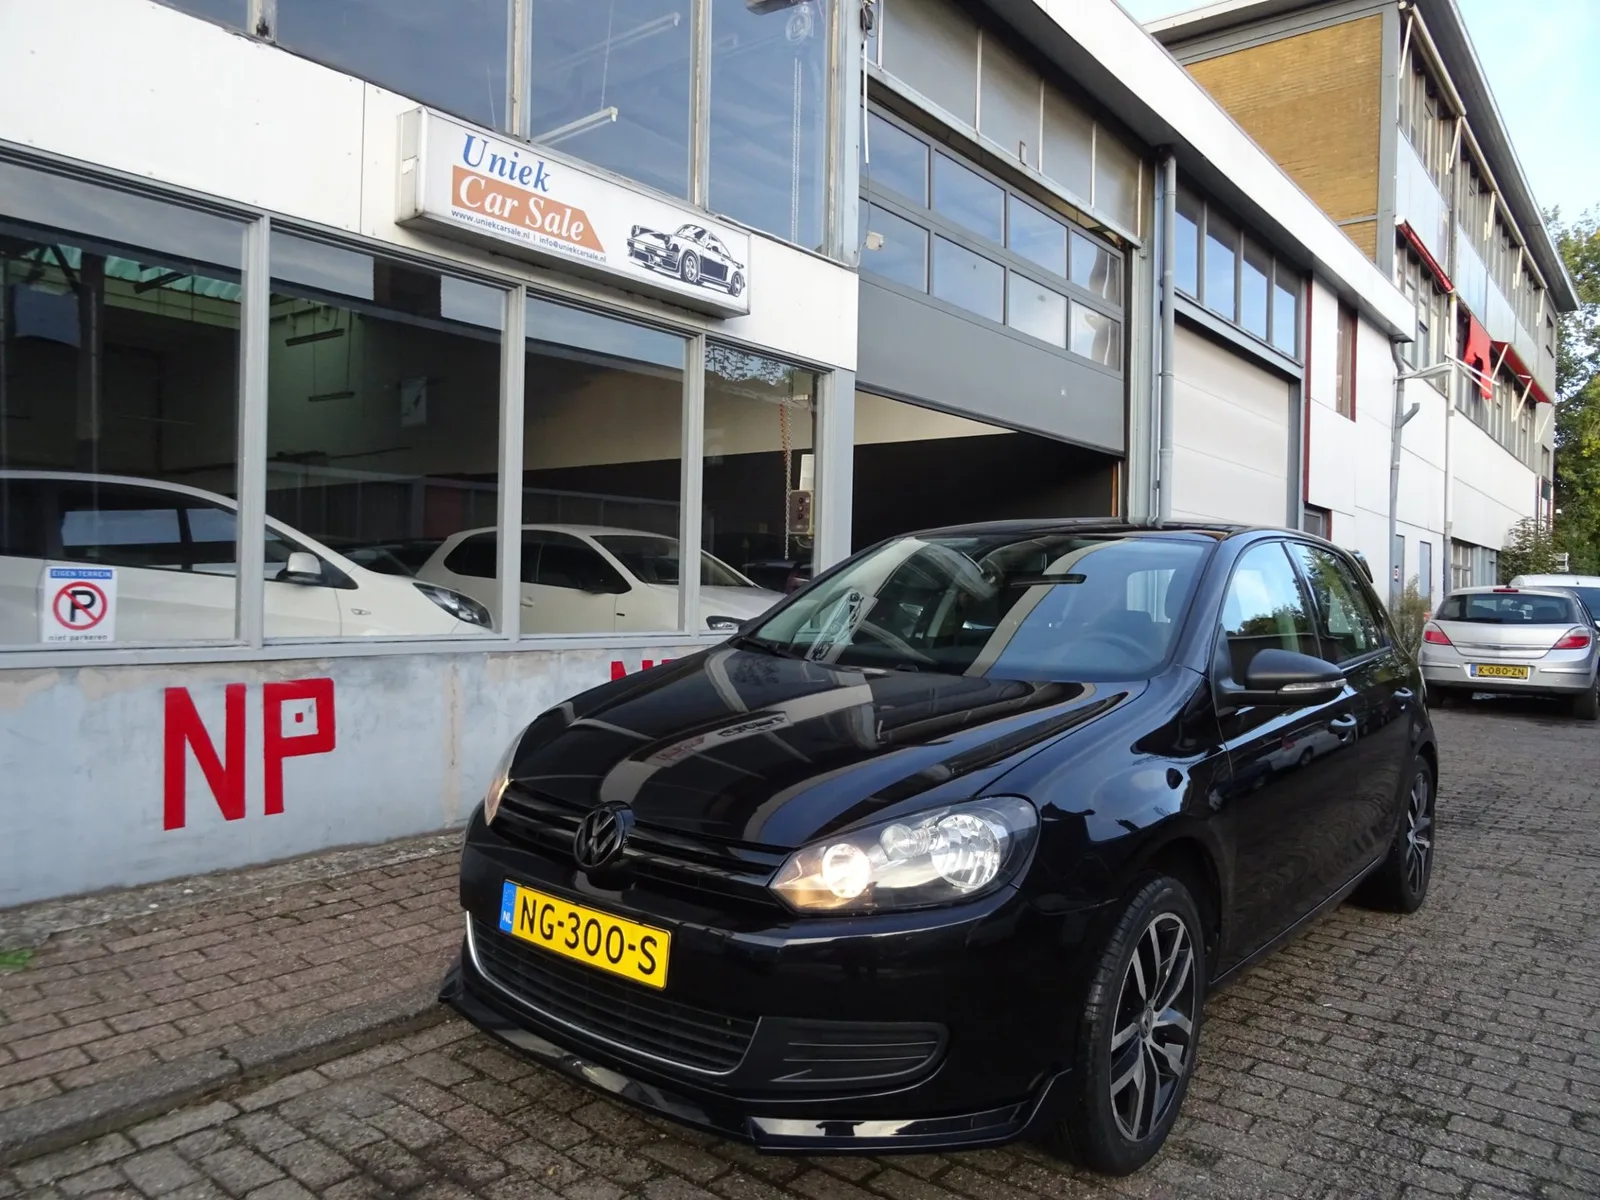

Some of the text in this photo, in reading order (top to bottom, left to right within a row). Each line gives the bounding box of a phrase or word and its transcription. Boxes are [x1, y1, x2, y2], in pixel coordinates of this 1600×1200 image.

[463, 133, 551, 192] Uniek
[451, 209, 607, 263] www.uniekcarsale.nl info@uniekcarsale.nl
[459, 175, 584, 241] Car Sale
[79, 570, 111, 578] TERREIN
[1477, 666, 1525, 676] K-080-ZN
[164, 677, 336, 831] NP
[502, 895, 658, 975] NL NG-300-S
